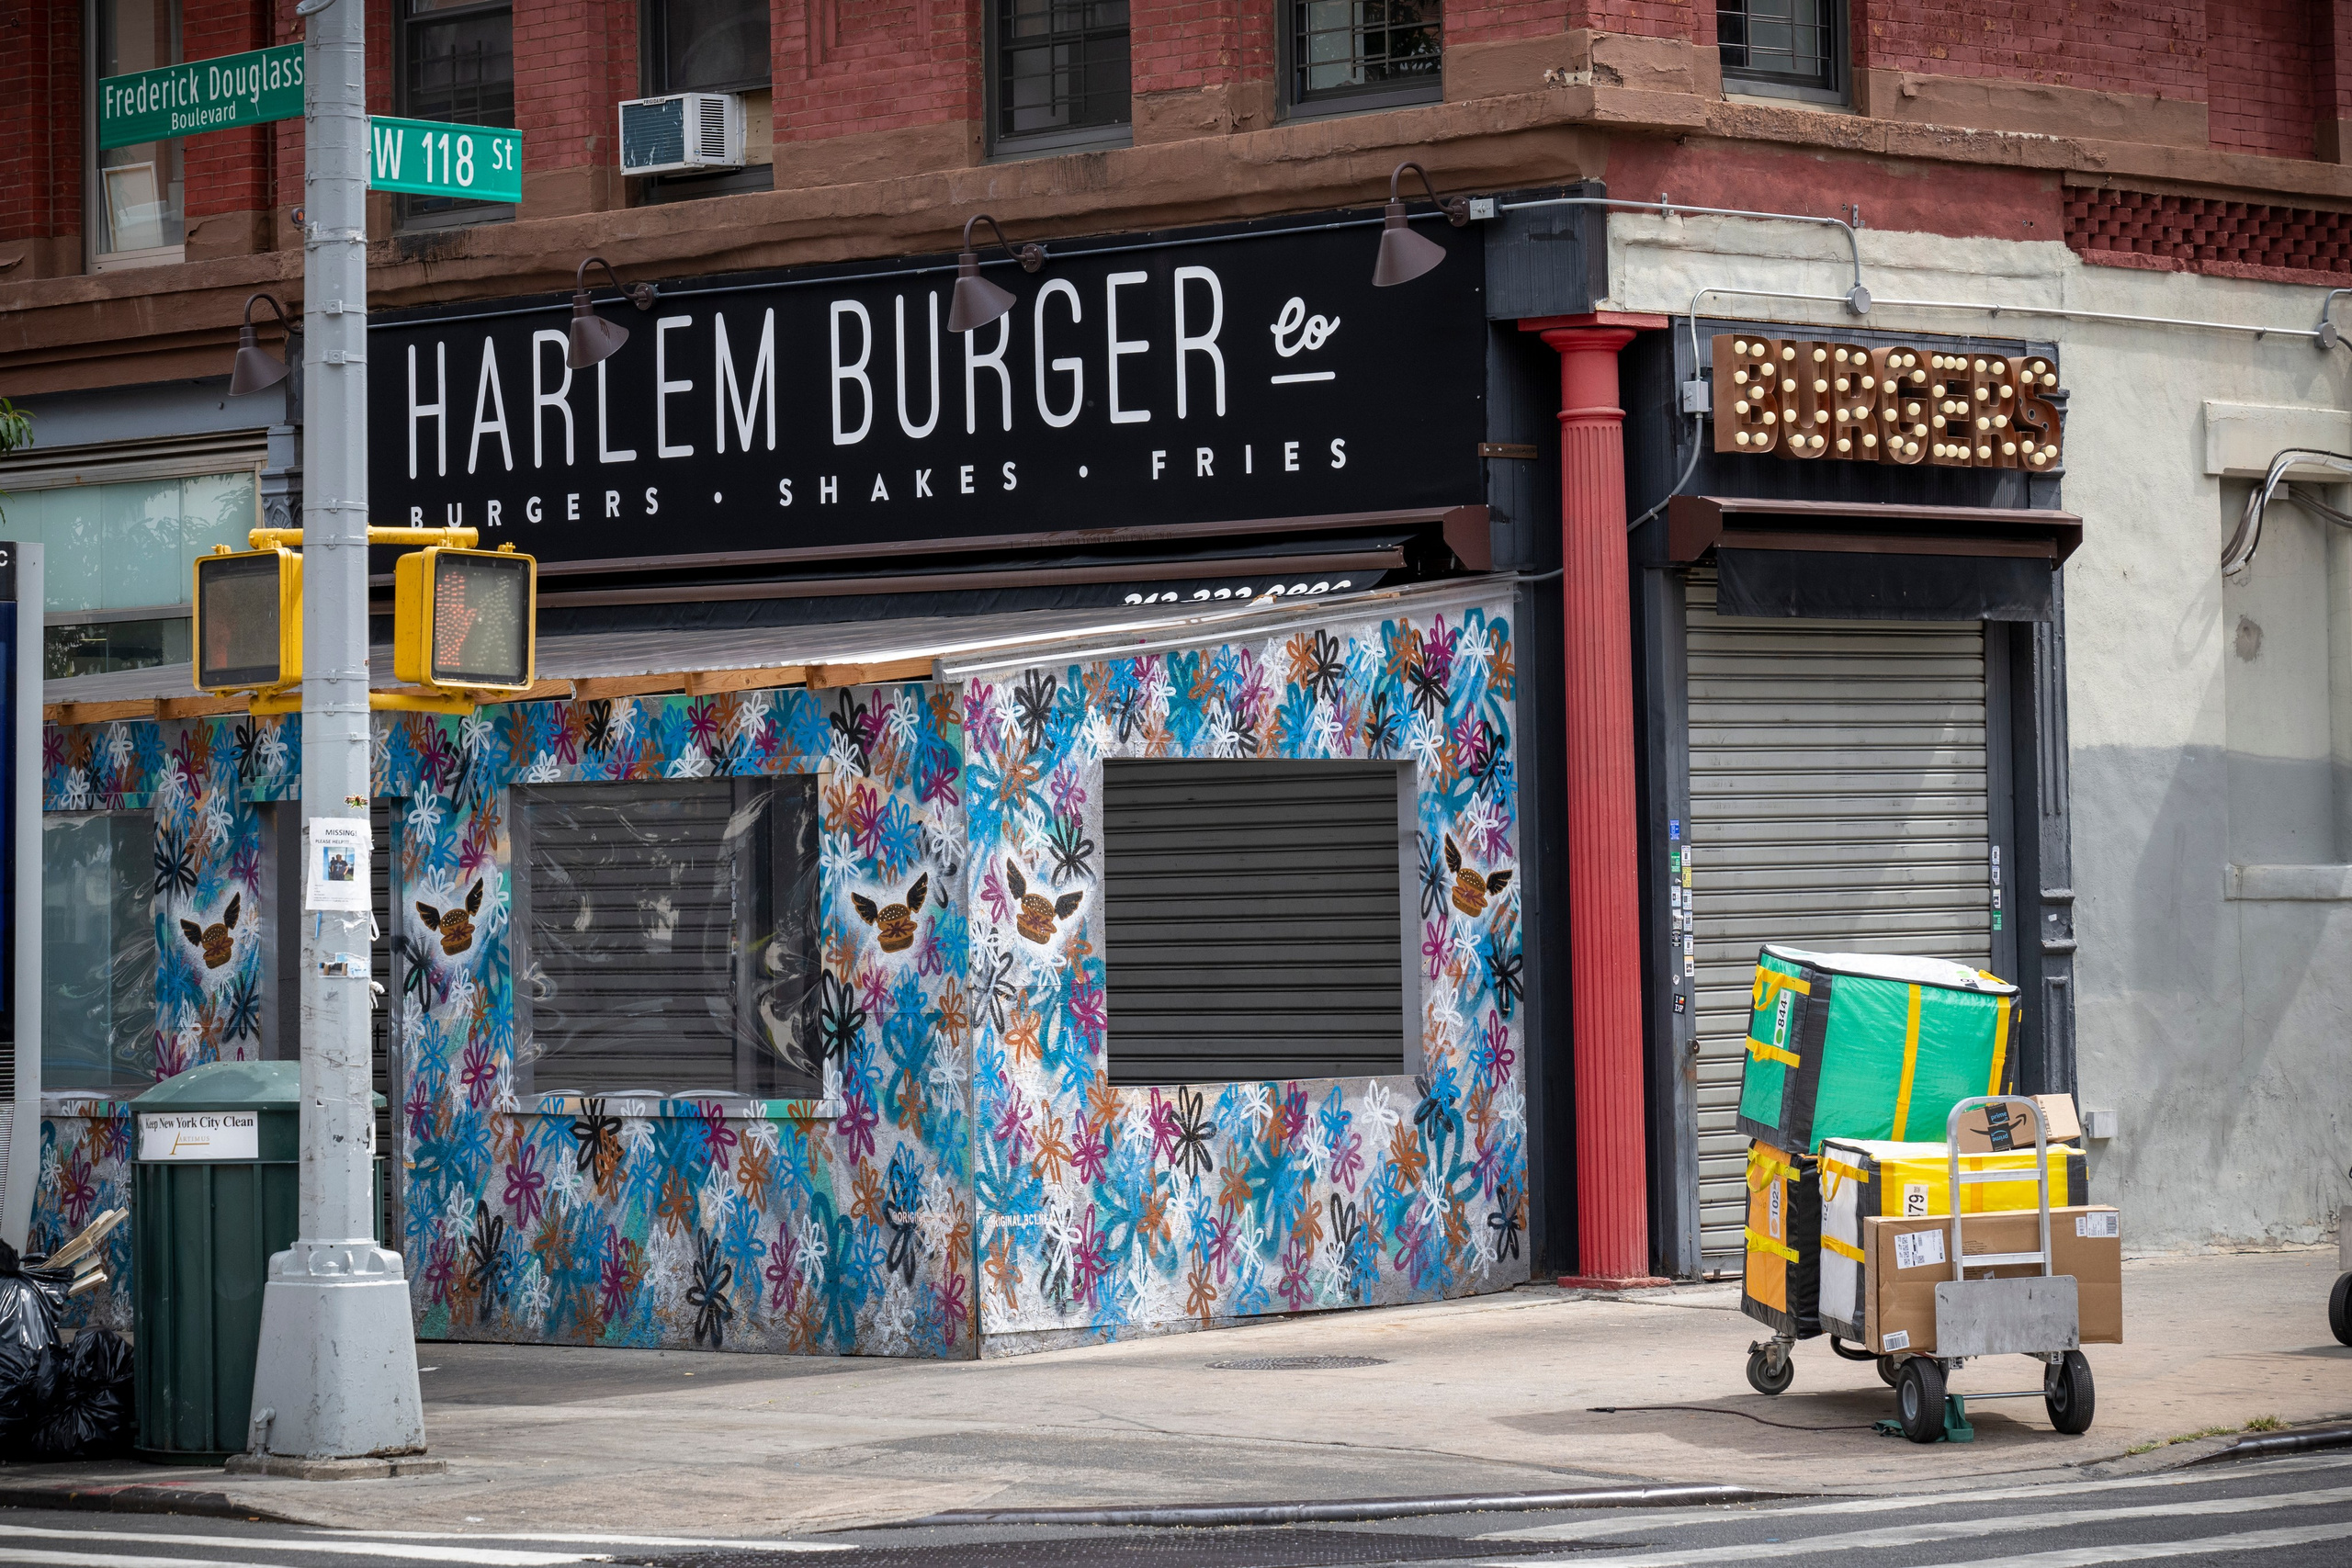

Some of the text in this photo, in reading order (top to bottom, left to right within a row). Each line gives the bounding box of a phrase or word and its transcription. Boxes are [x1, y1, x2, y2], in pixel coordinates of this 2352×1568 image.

[105, 53, 304, 119] Frederick Douglass
[171, 101, 236, 131] Boulevard
[374, 127, 513, 187] W 118 St
[407, 265, 1340, 479] HARLEM BURGER Co
[1712, 333, 2062, 472] BURGERS
[410, 437, 1347, 530] BURGERS SHAKES FRIES
[325, 829, 357, 837] MISSING!
[1778, 999, 1787, 1027] 844
[145, 1115, 254, 1132] Keep New York City Clean
[1990, 1111, 2007, 1121] prime
[1992, 1133, 2008, 1142] prime
[1771, 1190, 1780, 1217] 102
[1908, 1194, 1925, 1217] 79
